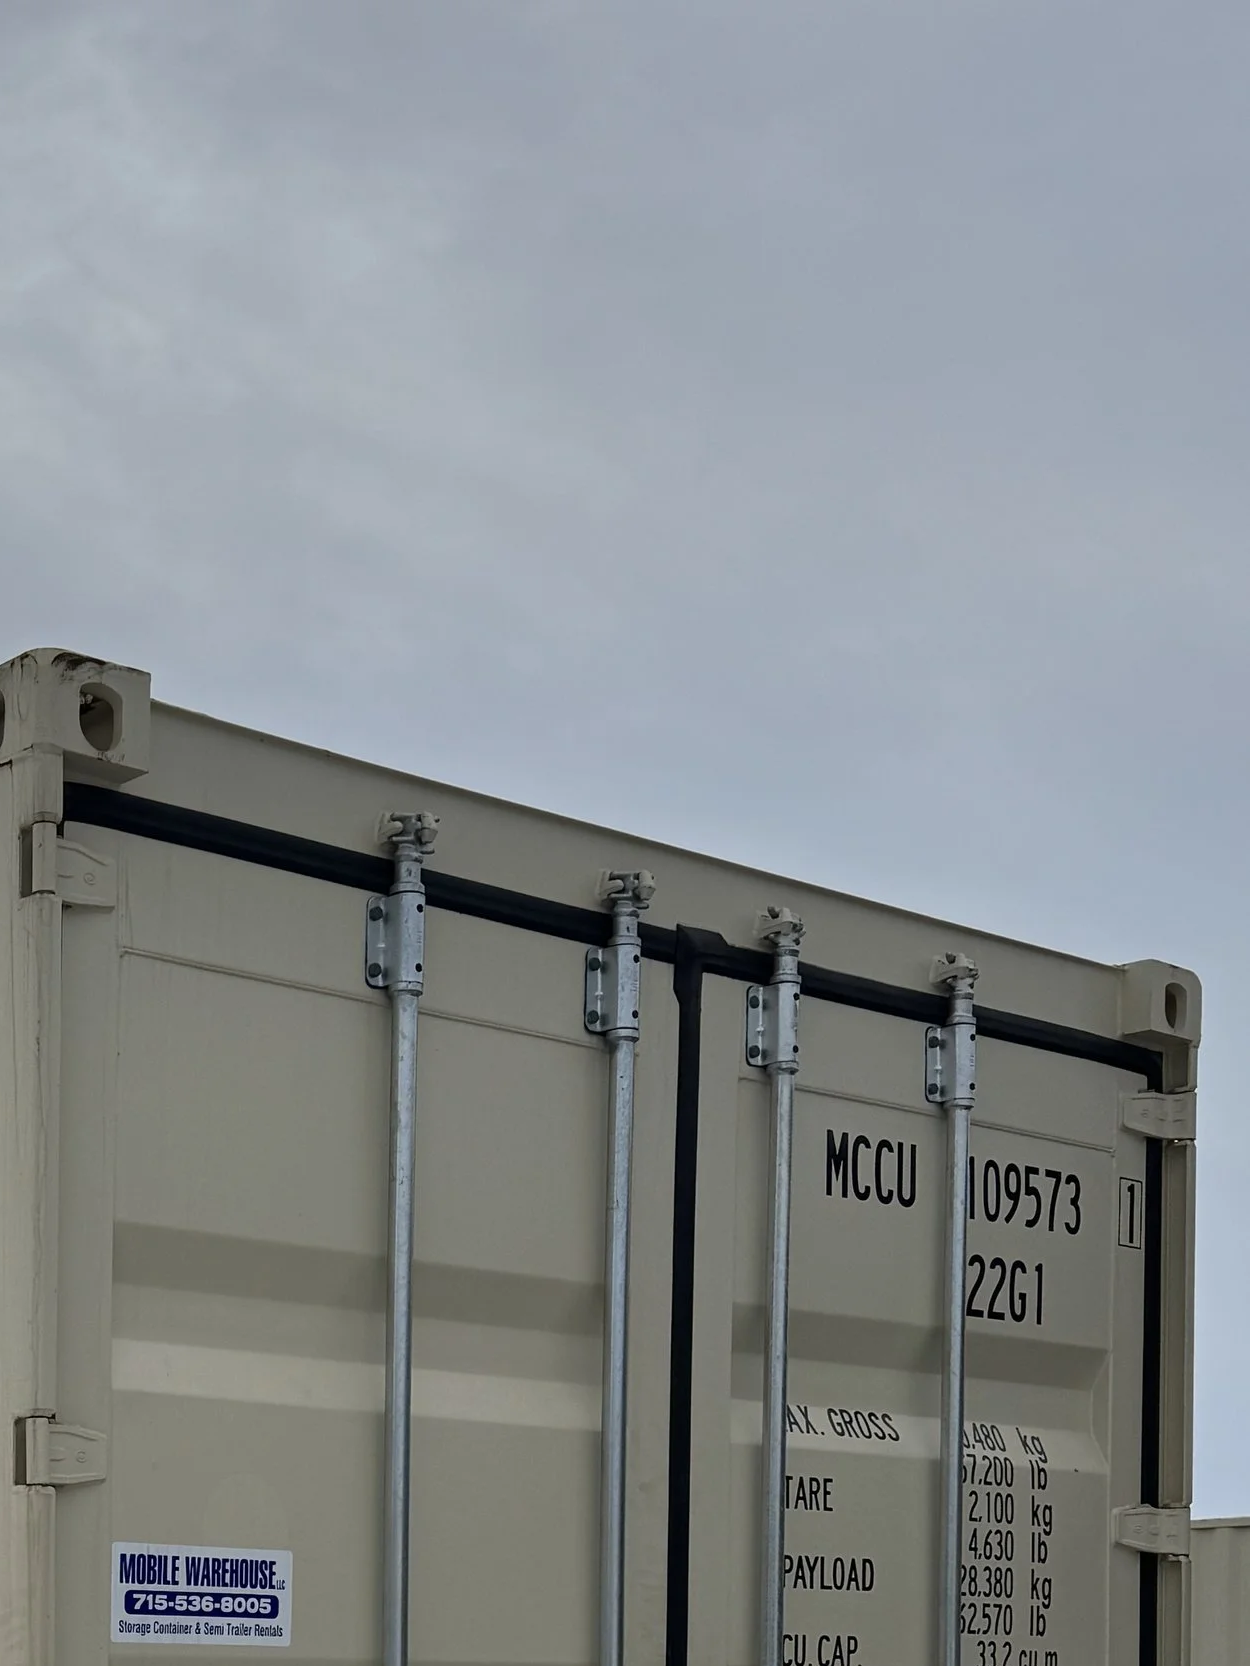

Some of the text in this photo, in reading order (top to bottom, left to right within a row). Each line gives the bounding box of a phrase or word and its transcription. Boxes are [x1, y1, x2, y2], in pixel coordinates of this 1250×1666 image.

[825, 1128, 917, 1208] MCCU
[969, 1155, 1082, 1236] 109573
[965, 1253, 1044, 1326] 22G1
[785, 1404, 826, 1437] AX.
[827, 1407, 901, 1442] GROSS
[1015, 1426, 1049, 1464] kg
[1029, 1459, 1048, 1491] lb
[785, 1475, 1053, 1537] TARE 2,100 kg
[968, 1527, 1048, 1565] 4,630 lb
[119, 1552, 286, 1591] MOBILE WAREHOUSE LLC
[783, 1554, 875, 1592] PAYLOAD
[1030, 1568, 1053, 1610] kg
[132, 1593, 273, 1614] 715-536-8005
[1029, 1604, 1047, 1638] lb
[118, 1619, 283, 1638] Storage Container & Semi Trailer Rentals
